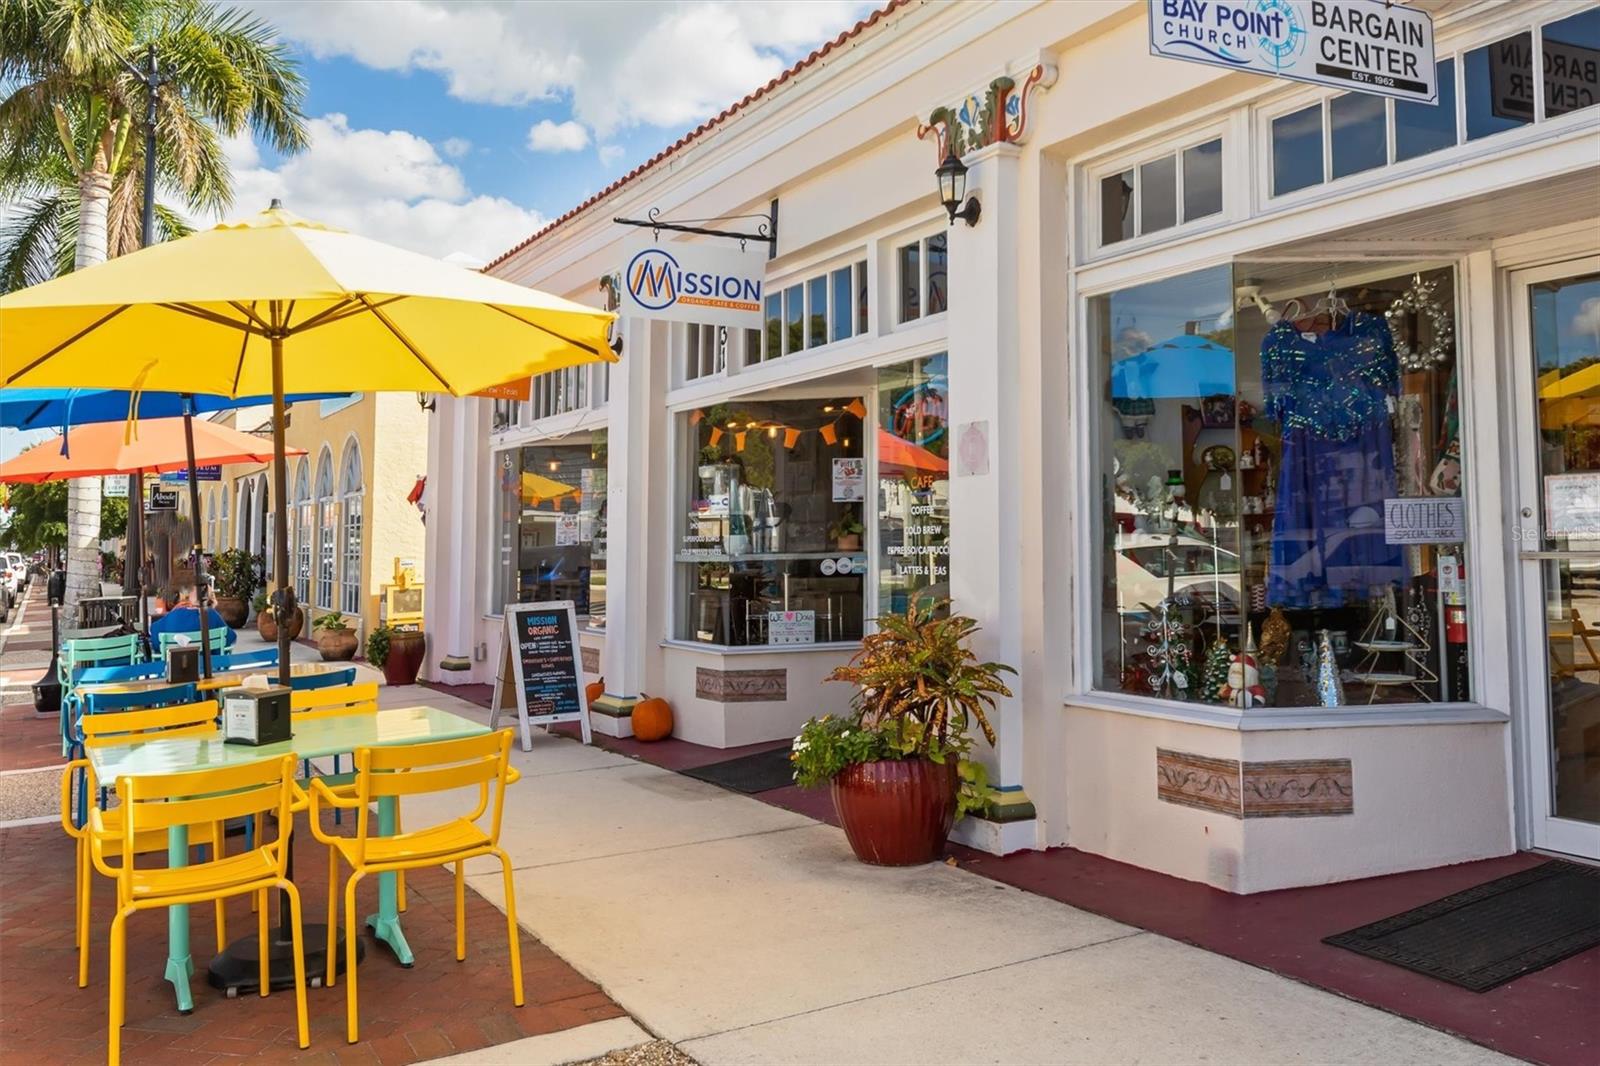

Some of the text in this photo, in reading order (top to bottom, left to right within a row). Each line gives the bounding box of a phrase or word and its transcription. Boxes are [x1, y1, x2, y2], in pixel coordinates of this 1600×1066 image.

[1163, 0, 1207, 23] BAY
[1312, 1, 1425, 48] BARGAIN
[1163, 21, 1247, 49] CHURCH
[1319, 36, 1419, 78] CENTER
[1351, 71, 1395, 87] EST. 1962
[630, 257, 761, 302] MISSION
[681, 296, 711, 305] ORGANIC
[911, 475, 934, 489] CAFE
[911, 505, 934, 515] COFFEE
[1390, 503, 1455, 529] CLOTHES
[905, 525, 942, 535] COLD BREW
[900, 565, 923, 575] LATTES
[930, 566, 947, 576] EAS
[527, 616, 558, 625] MISSION
[527, 625, 560, 636] ORGANIC
